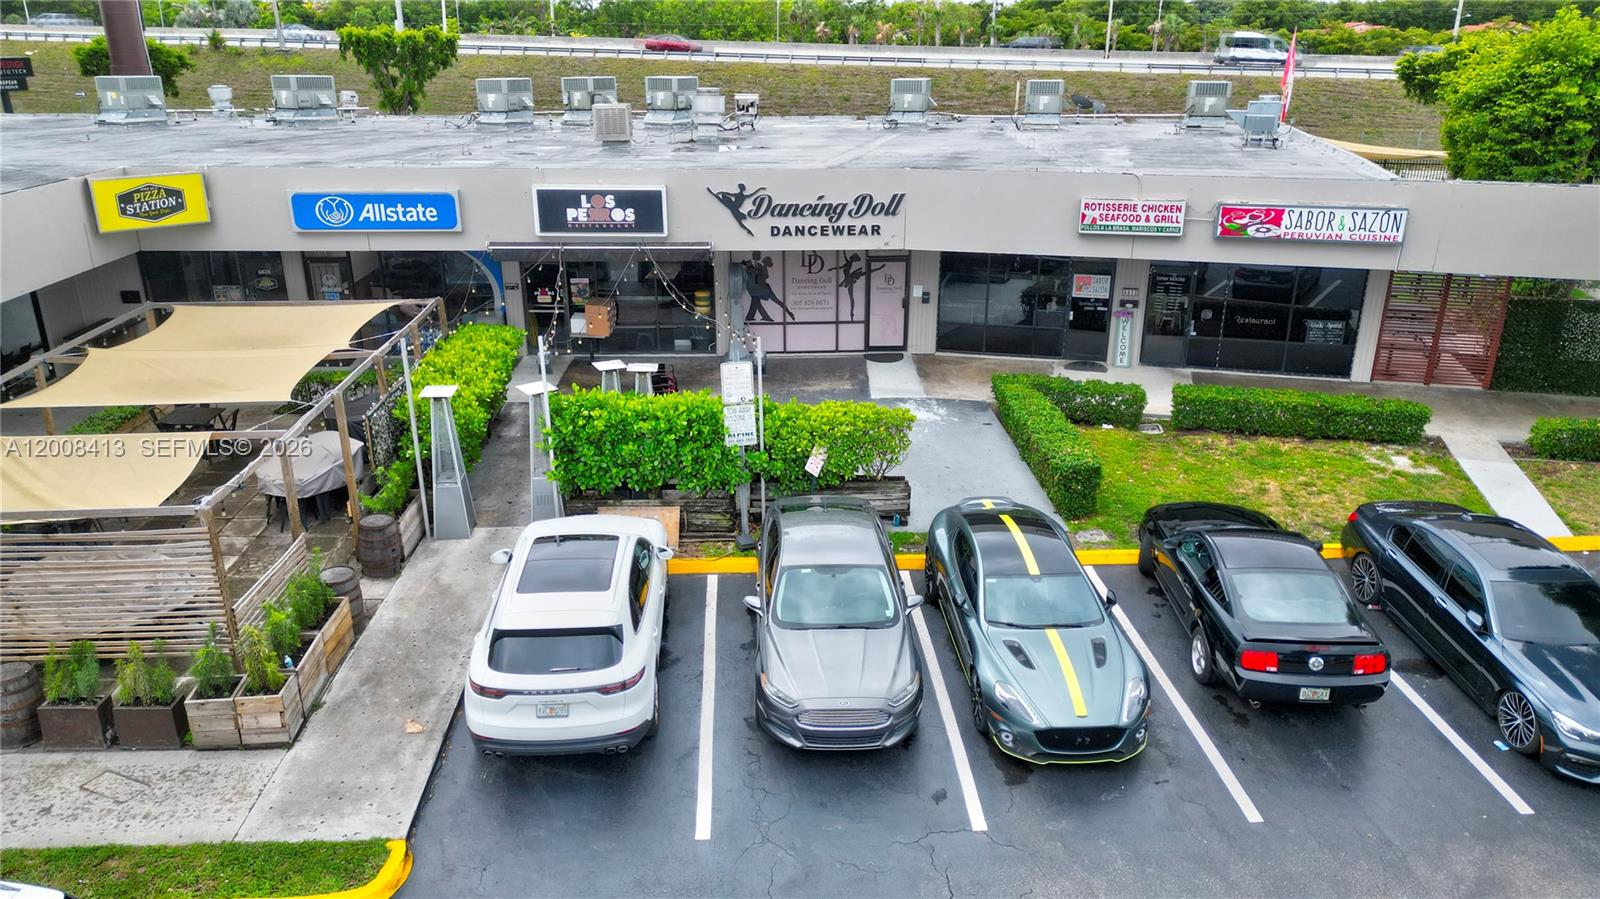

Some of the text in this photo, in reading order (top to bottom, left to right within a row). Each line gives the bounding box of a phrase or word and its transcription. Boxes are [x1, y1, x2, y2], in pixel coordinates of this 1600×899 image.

[134, 189, 166, 203] PIZZA
[580, 194, 616, 208] LOS
[126, 196, 176, 215] STATION
[358, 203, 438, 222] Allstate
[746, 193, 906, 223] Dancing Doll
[1083, 202, 1182, 214] ROTISSERIE CHICKEN
[1098, 213, 1181, 224] SEAFOOD & GRILL
[1285, 209, 1403, 233] SABOR & SAZÓN
[770, 225, 882, 237] DANCEWEAR
[1283, 231, 1400, 242] PERUVIAN CUISINE
[1119, 318, 1130, 364] WELCOME
